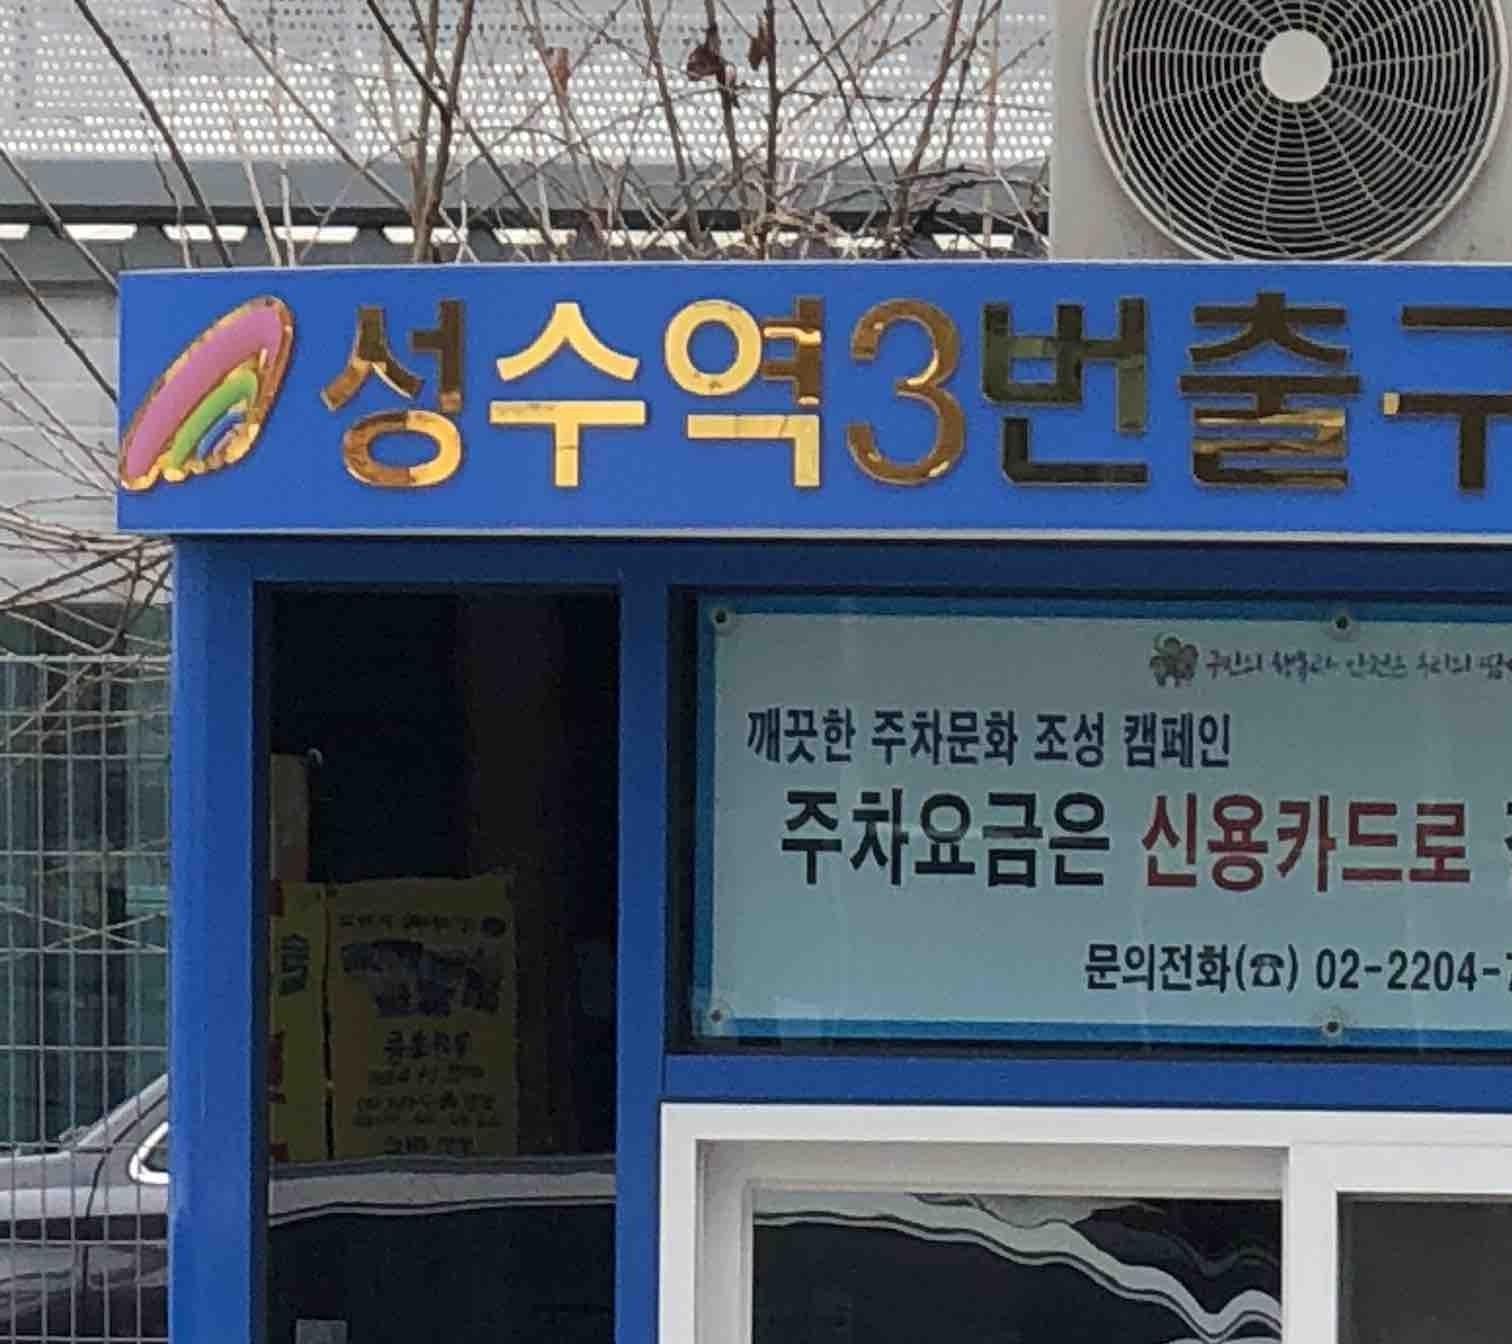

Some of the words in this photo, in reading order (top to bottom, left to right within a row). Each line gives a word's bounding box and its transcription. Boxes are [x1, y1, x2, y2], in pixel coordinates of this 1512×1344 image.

[747, 706, 856, 764] 깨끗한
[871, 708, 1019, 766] 주차문화
[1033, 711, 1105, 768] 조성
[1124, 713, 1232, 769] 캠페인
[781, 788, 1110, 887] 주차요금은
[1142, 793, 1472, 892] 신용카드로
